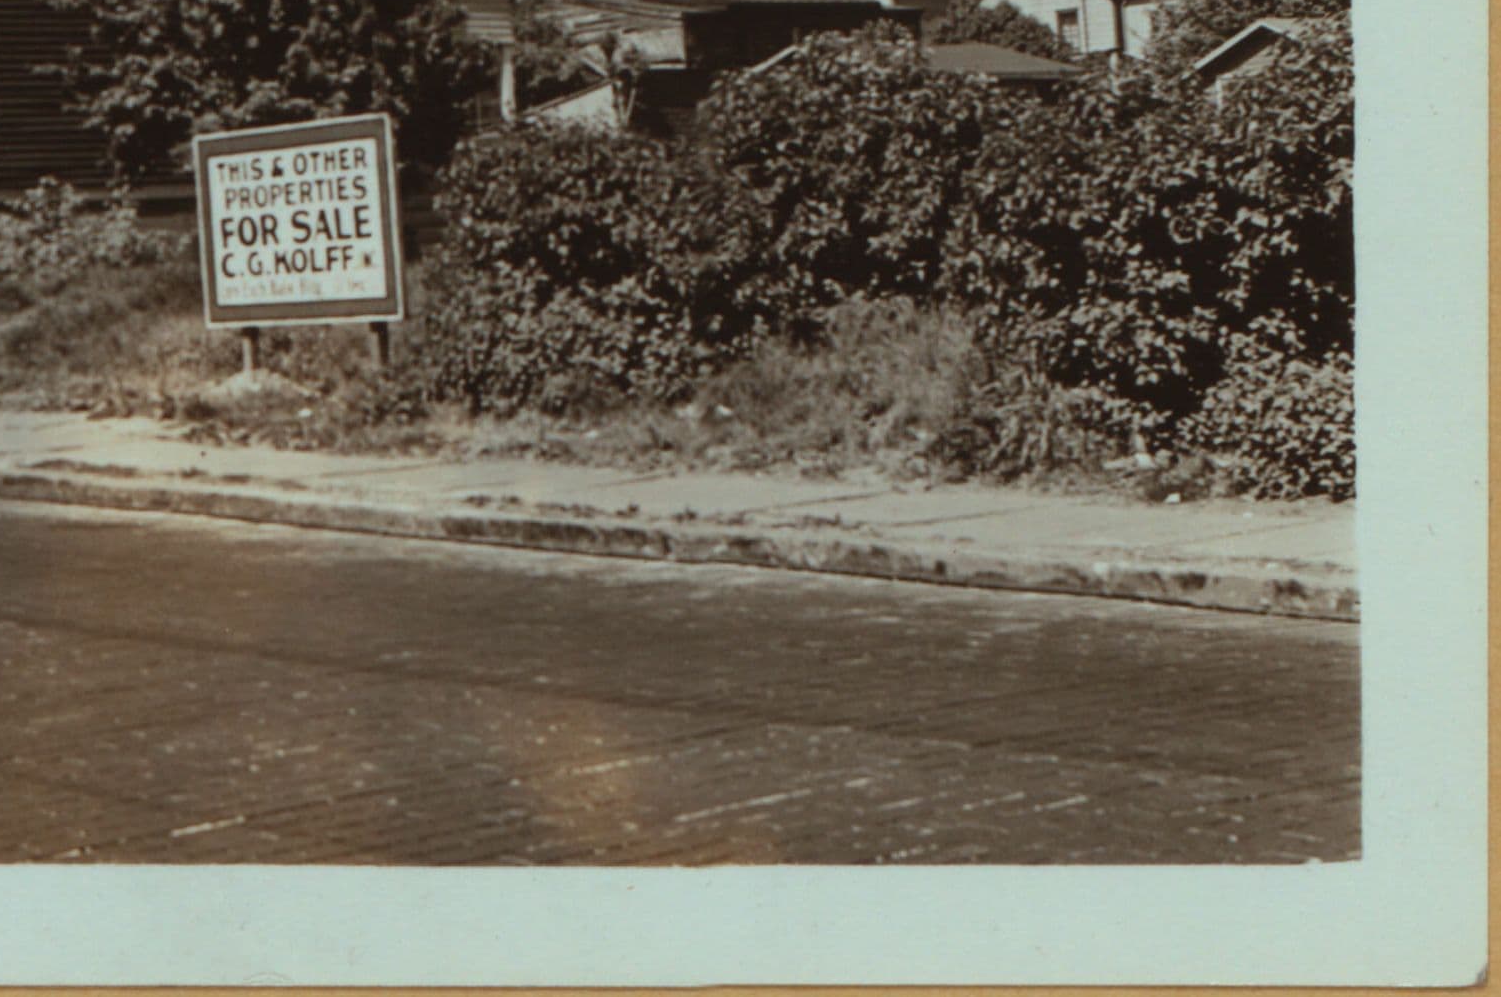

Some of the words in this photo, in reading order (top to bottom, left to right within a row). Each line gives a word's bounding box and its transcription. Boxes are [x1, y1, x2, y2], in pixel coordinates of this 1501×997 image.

[216, 158, 264, 183] THIS
[271, 156, 285, 178] &
[293, 147, 367, 175] OTHER
[224, 176, 367, 210] PROPERTIES
[220, 213, 279, 248] FOR
[291, 205, 372, 244] SALE
